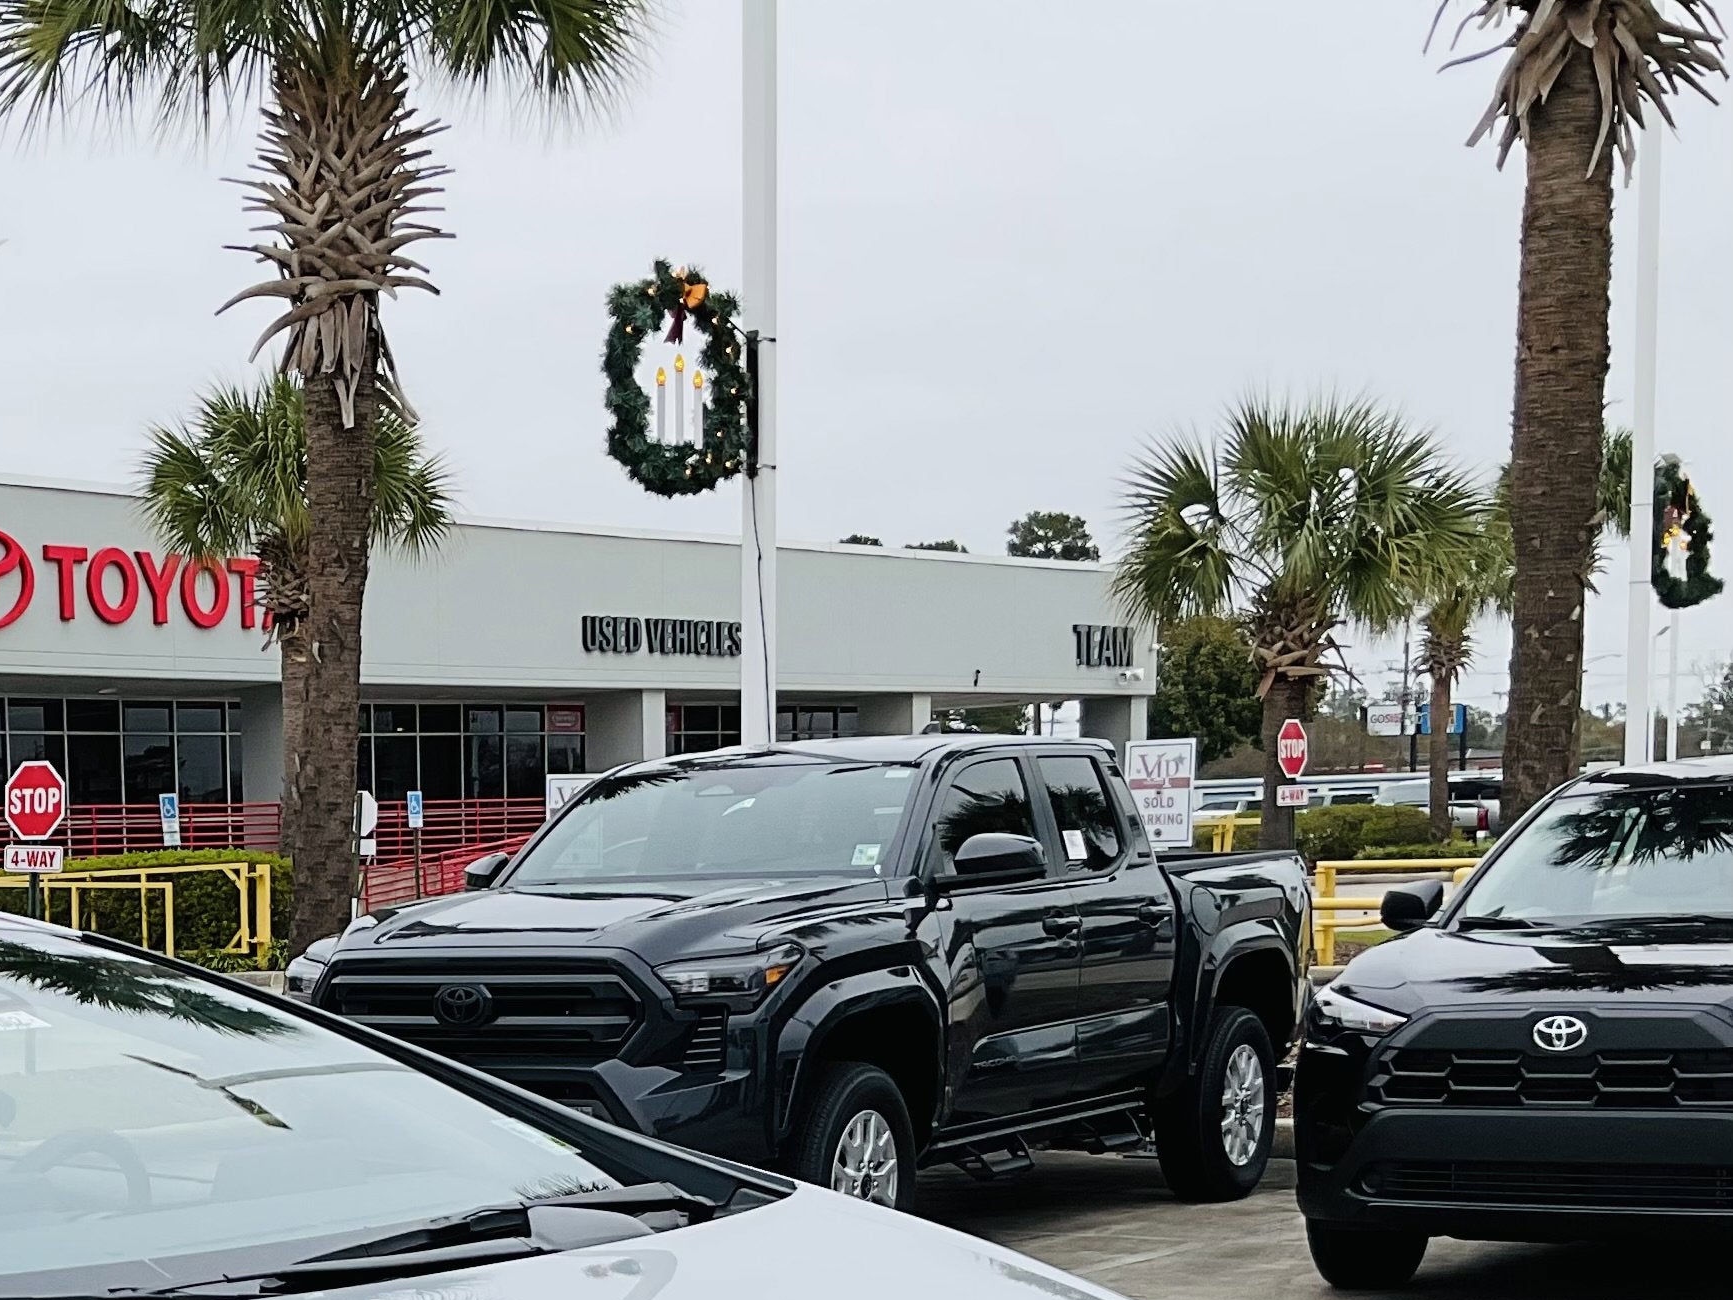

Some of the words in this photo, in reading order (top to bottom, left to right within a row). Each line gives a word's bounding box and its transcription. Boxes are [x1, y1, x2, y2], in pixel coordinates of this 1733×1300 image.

[43, 544, 274, 632] TOYOT
[582, 615, 642, 652] USED
[645, 618, 742, 656] VEHICLES
[1073, 624, 1134, 667] TEAM
[1280, 739, 1305, 759] STOP
[9, 787, 60, 815] STOP
[1143, 797, 1175, 809] SOLD
[1280, 789, 1304, 802] 4-WAY
[10, 850, 56, 868] 4-WAY
